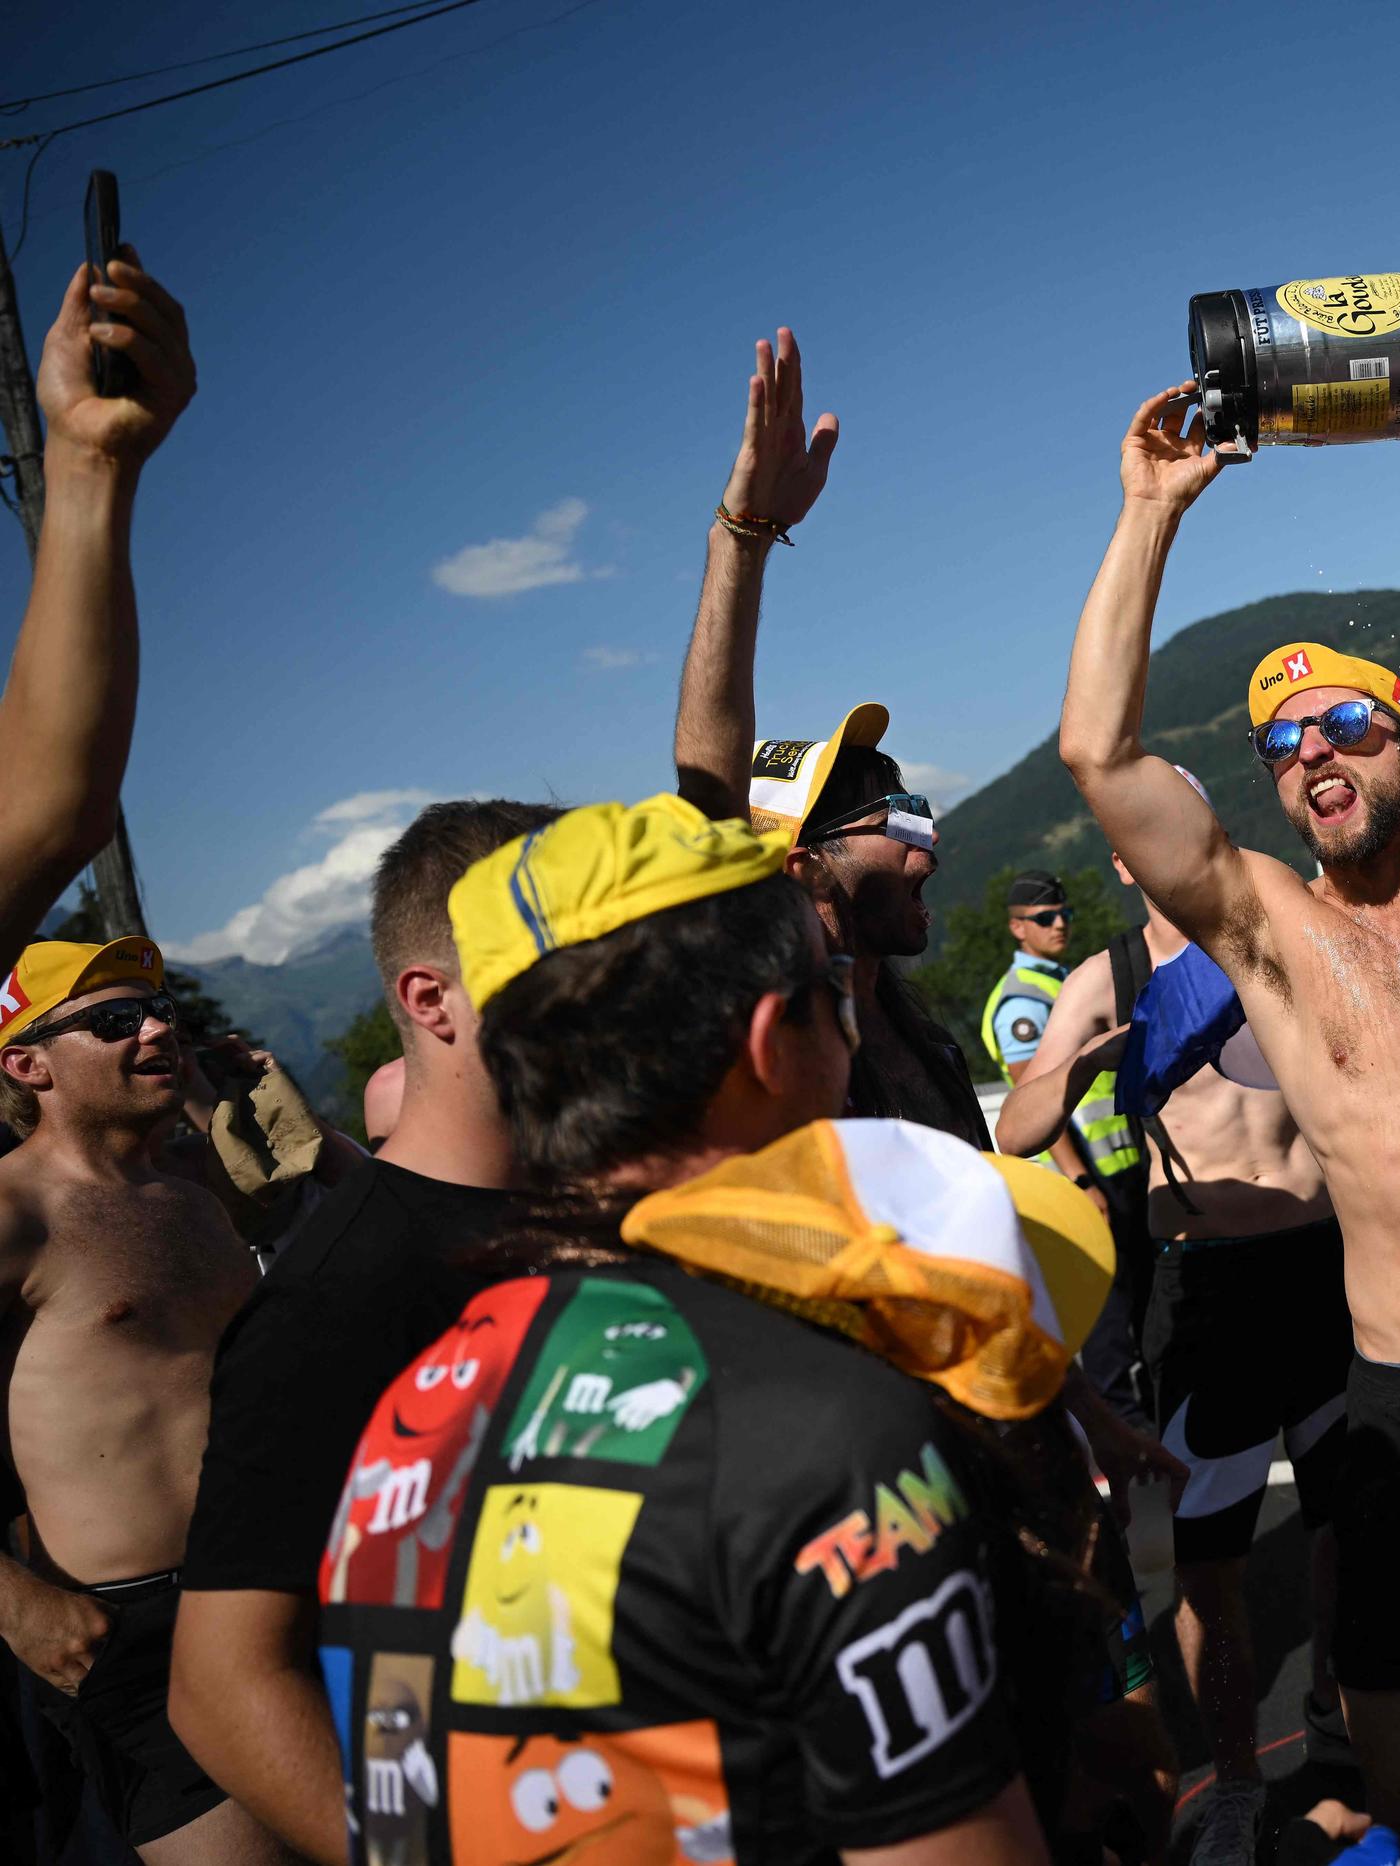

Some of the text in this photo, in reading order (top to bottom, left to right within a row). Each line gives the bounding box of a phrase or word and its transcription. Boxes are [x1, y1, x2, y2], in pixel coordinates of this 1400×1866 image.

[1323, 288, 1349, 308] la
[1253, 317, 1271, 346] FÛT
[1259, 652, 1309, 691] Uno X
[116, 948, 154, 969] Uno X
[563, 1373, 613, 1414] m
[367, 1459, 432, 1534] m
[795, 1442, 969, 1599] TEAM
[836, 1568, 996, 1779] m
[365, 1758, 406, 1817] m
